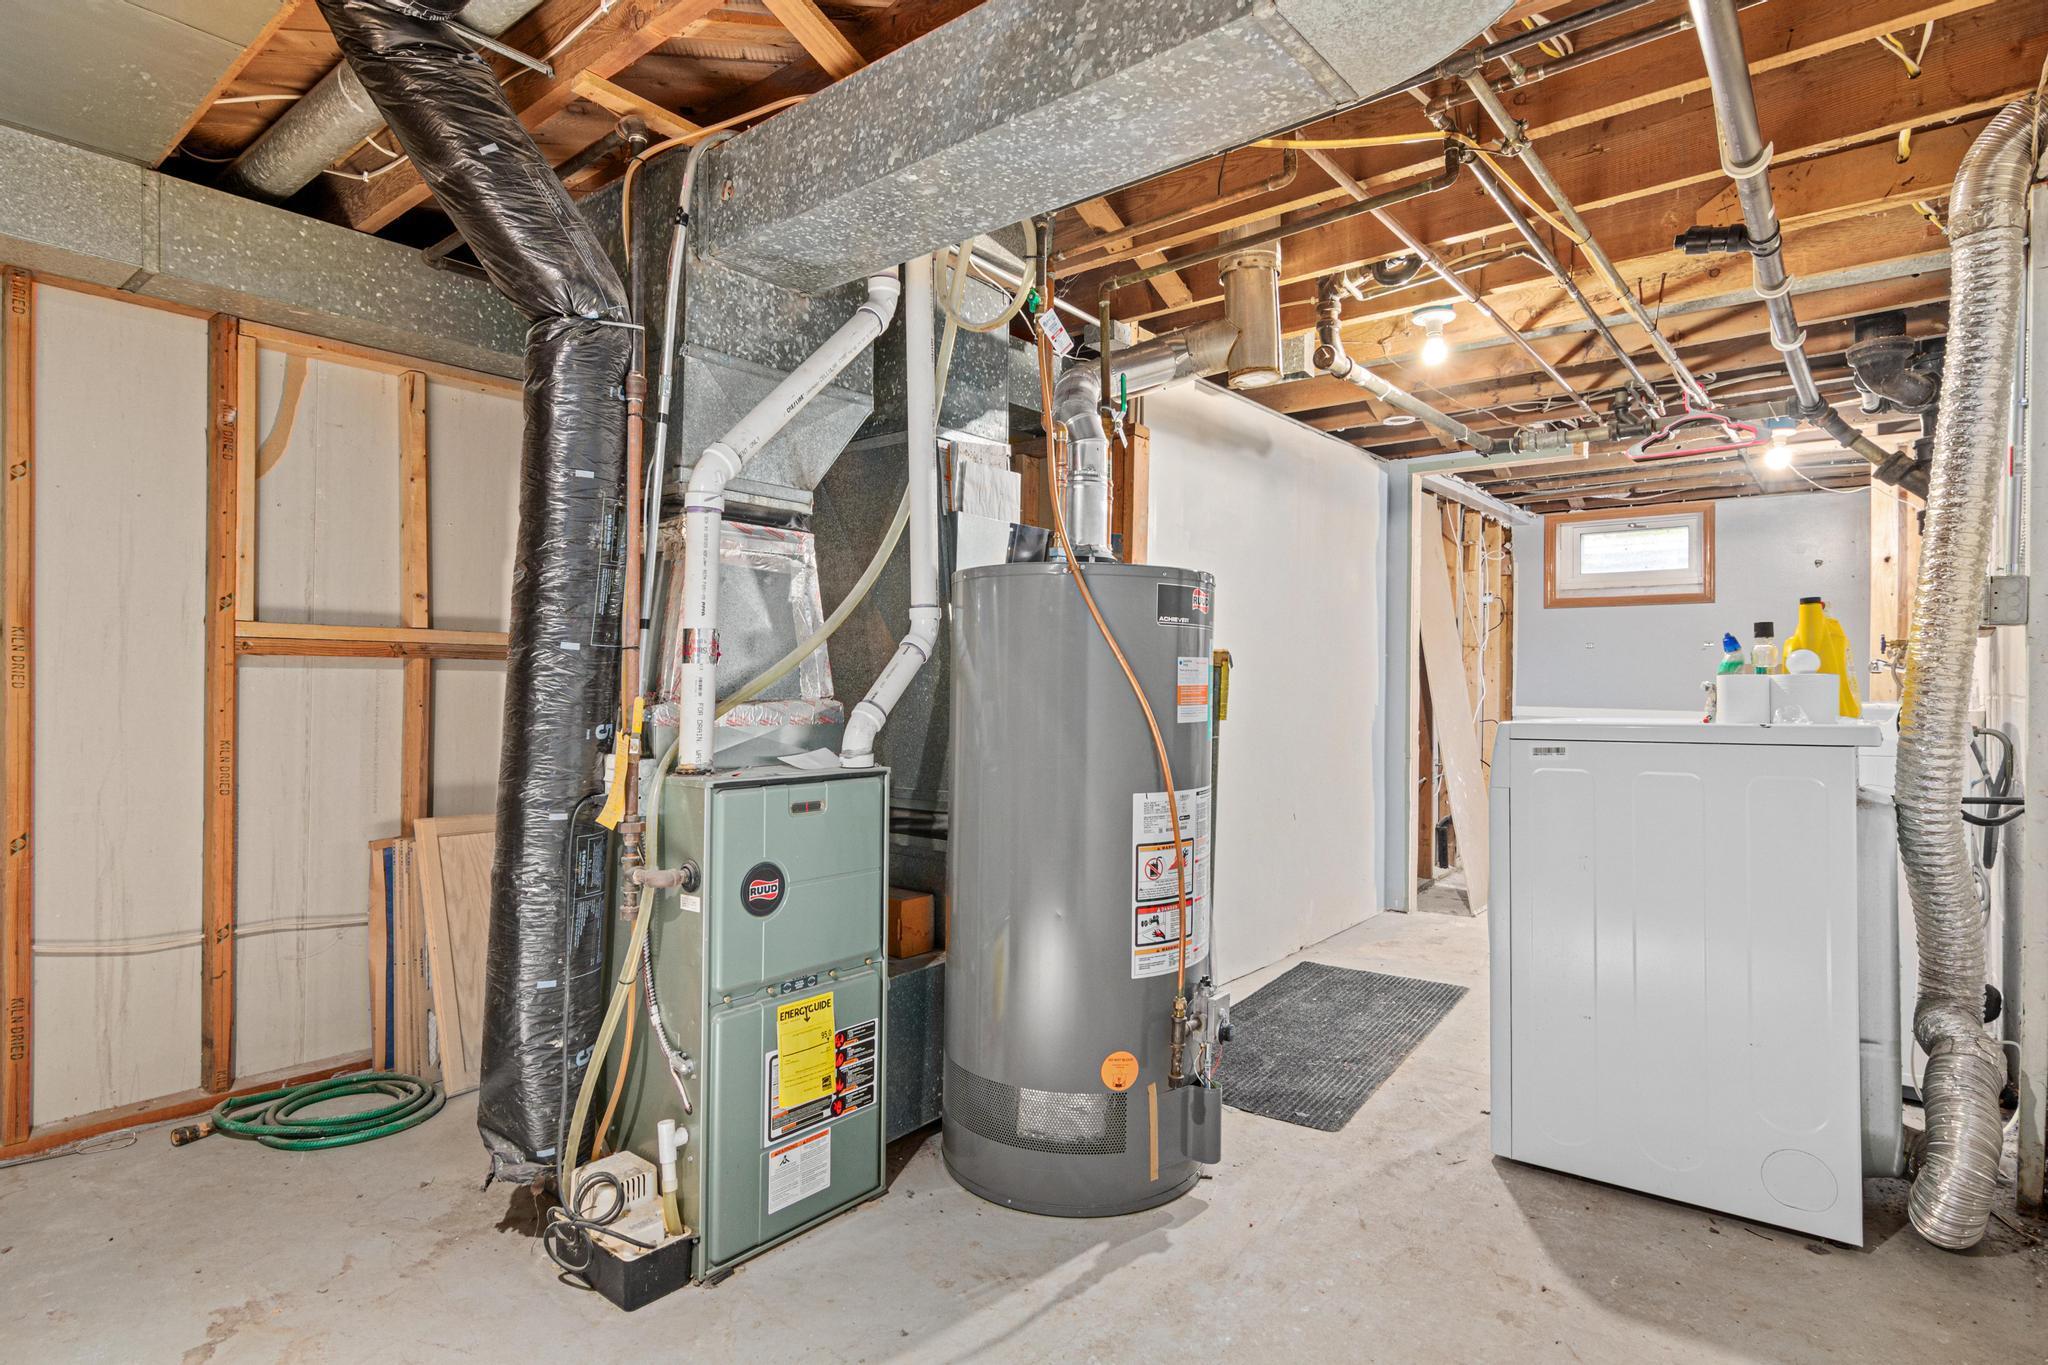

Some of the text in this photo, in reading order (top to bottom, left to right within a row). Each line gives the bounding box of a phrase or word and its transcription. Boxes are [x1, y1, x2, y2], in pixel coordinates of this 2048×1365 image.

[12, 279, 26, 315] DRIED
[223, 428, 234, 461] DRIED
[11, 626, 25, 689] KILN DRIED
[219, 739, 231, 796] KILN DRIED
[750, 884, 778, 896] RUUD
[780, 998, 832, 1021] ENERGYGUIDE
[10, 997, 25, 1061] KILN DRIED
